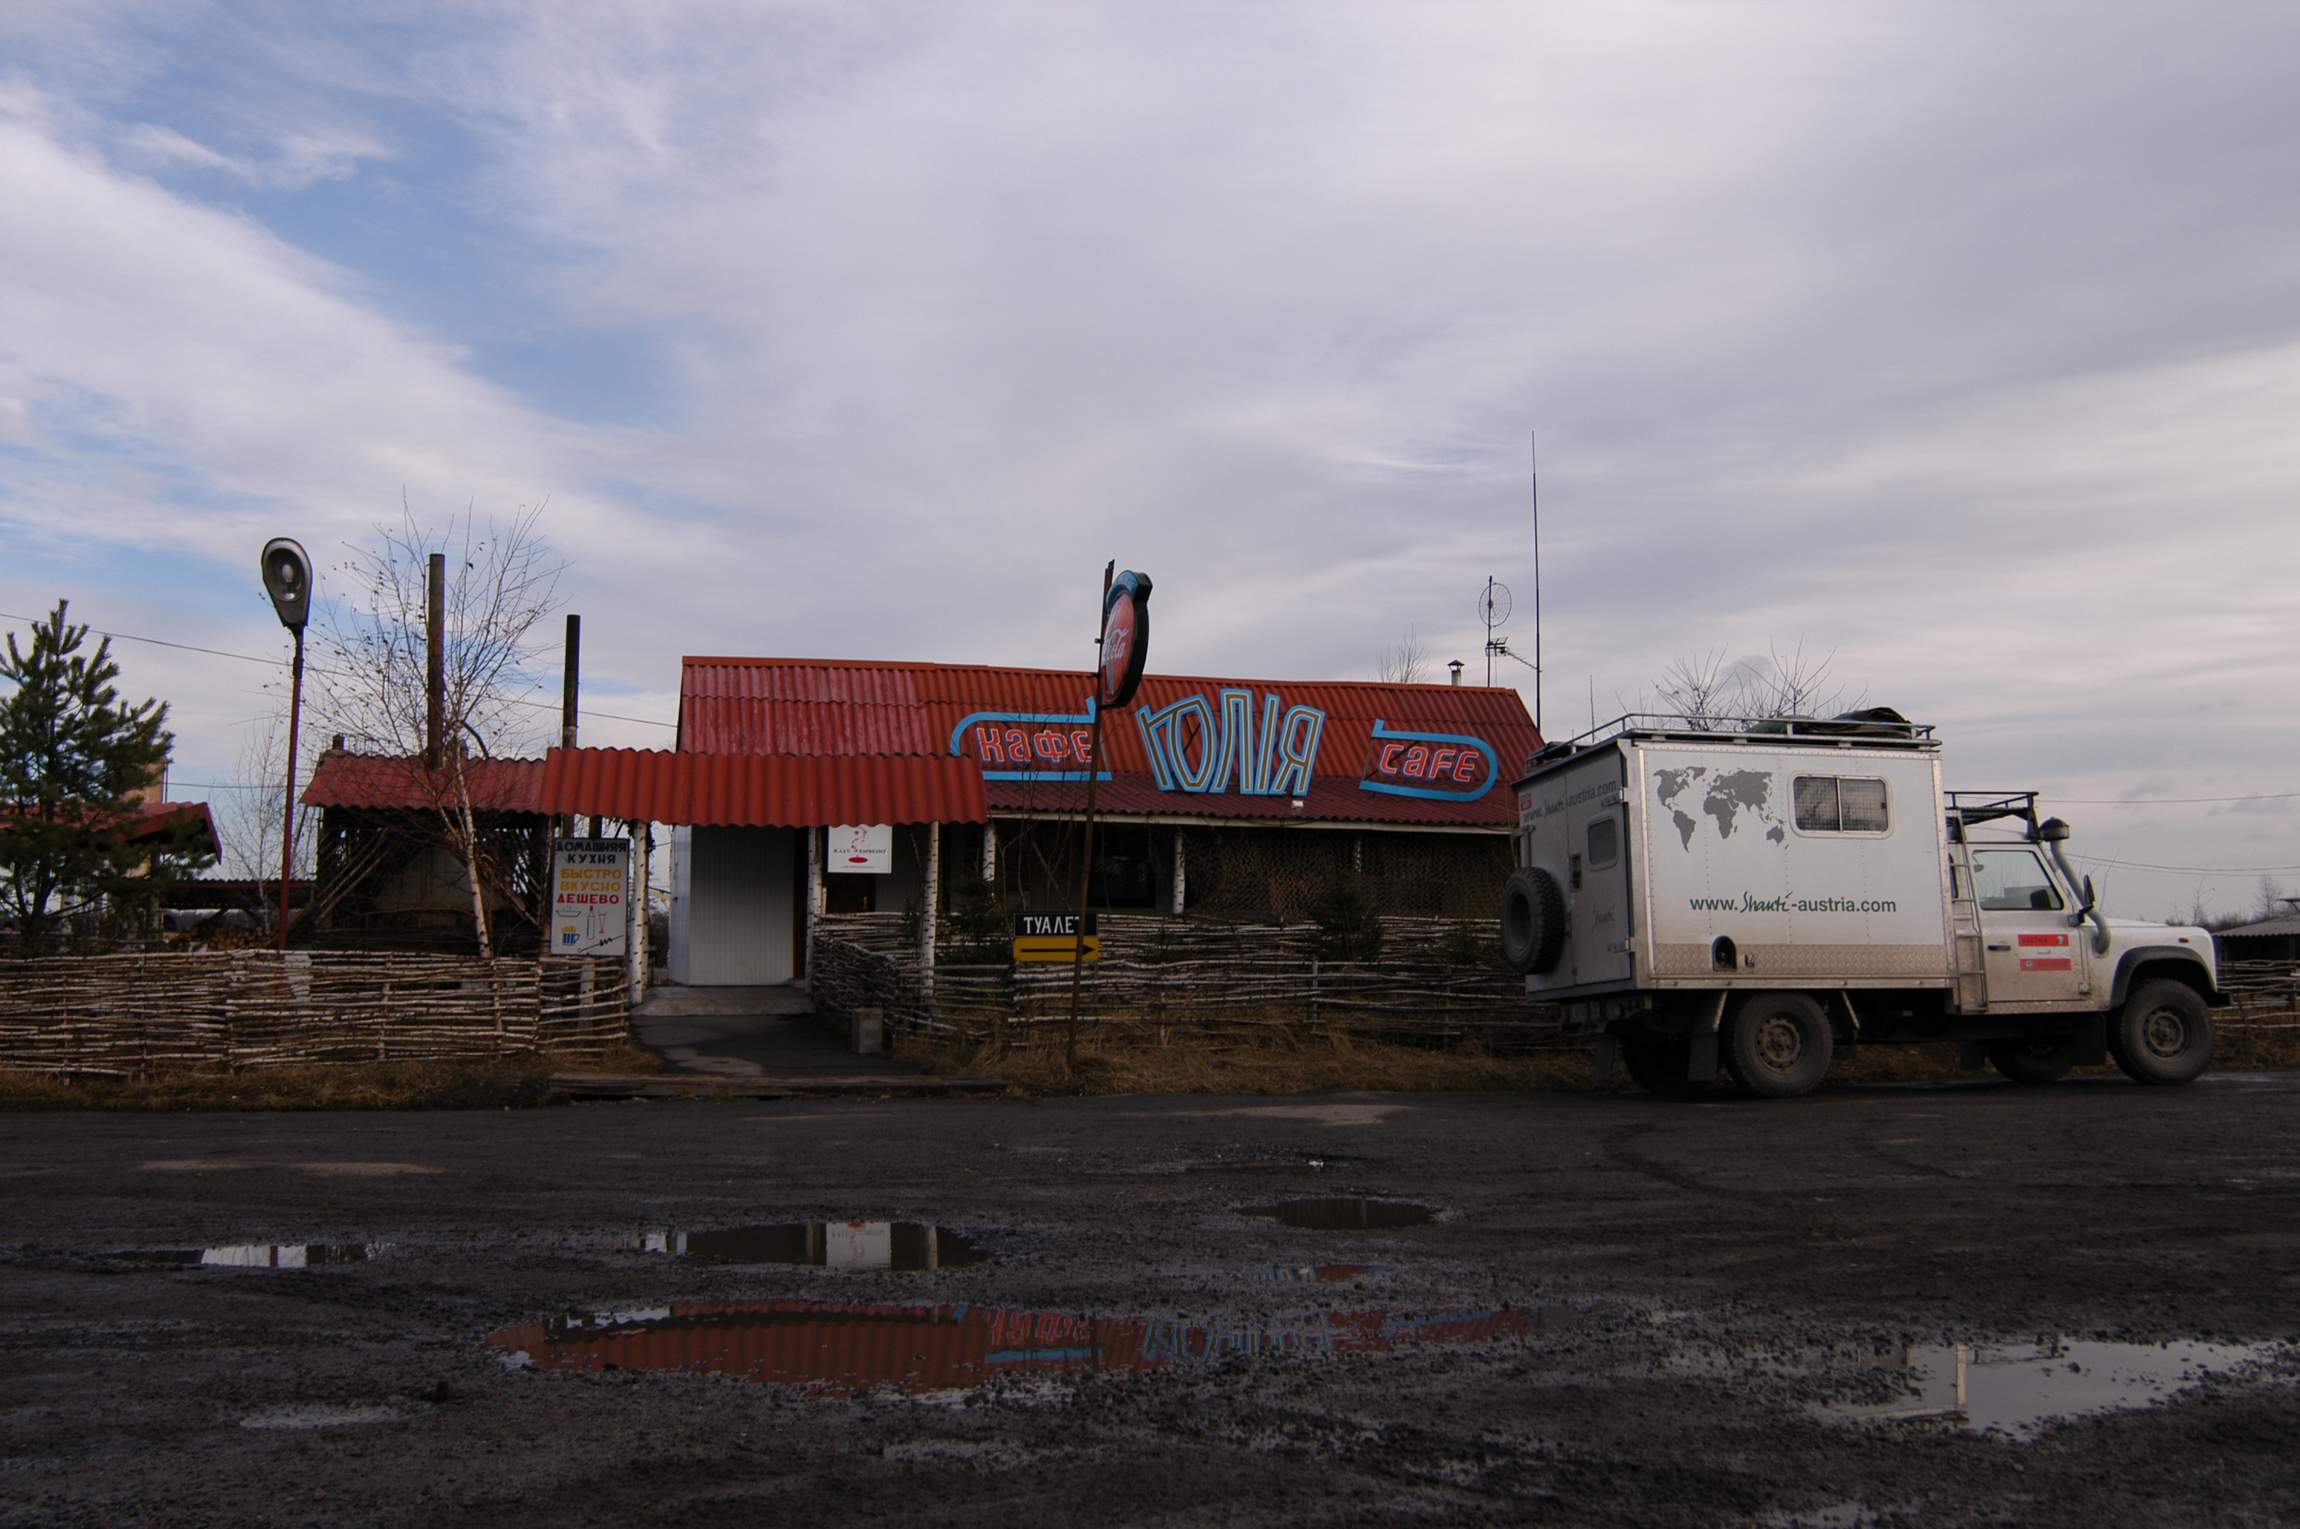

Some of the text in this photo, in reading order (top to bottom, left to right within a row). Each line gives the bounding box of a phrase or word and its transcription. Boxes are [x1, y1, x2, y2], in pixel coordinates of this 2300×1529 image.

[556, 840, 627, 853] ДОМАШНЯЯ
[567, 853, 616, 864] КУХНЯ
[560, 869, 622, 880] БЫСТРО
[559, 881, 621, 893] ВКУСНО
[556, 893, 620, 905] ДЕШЕВО
